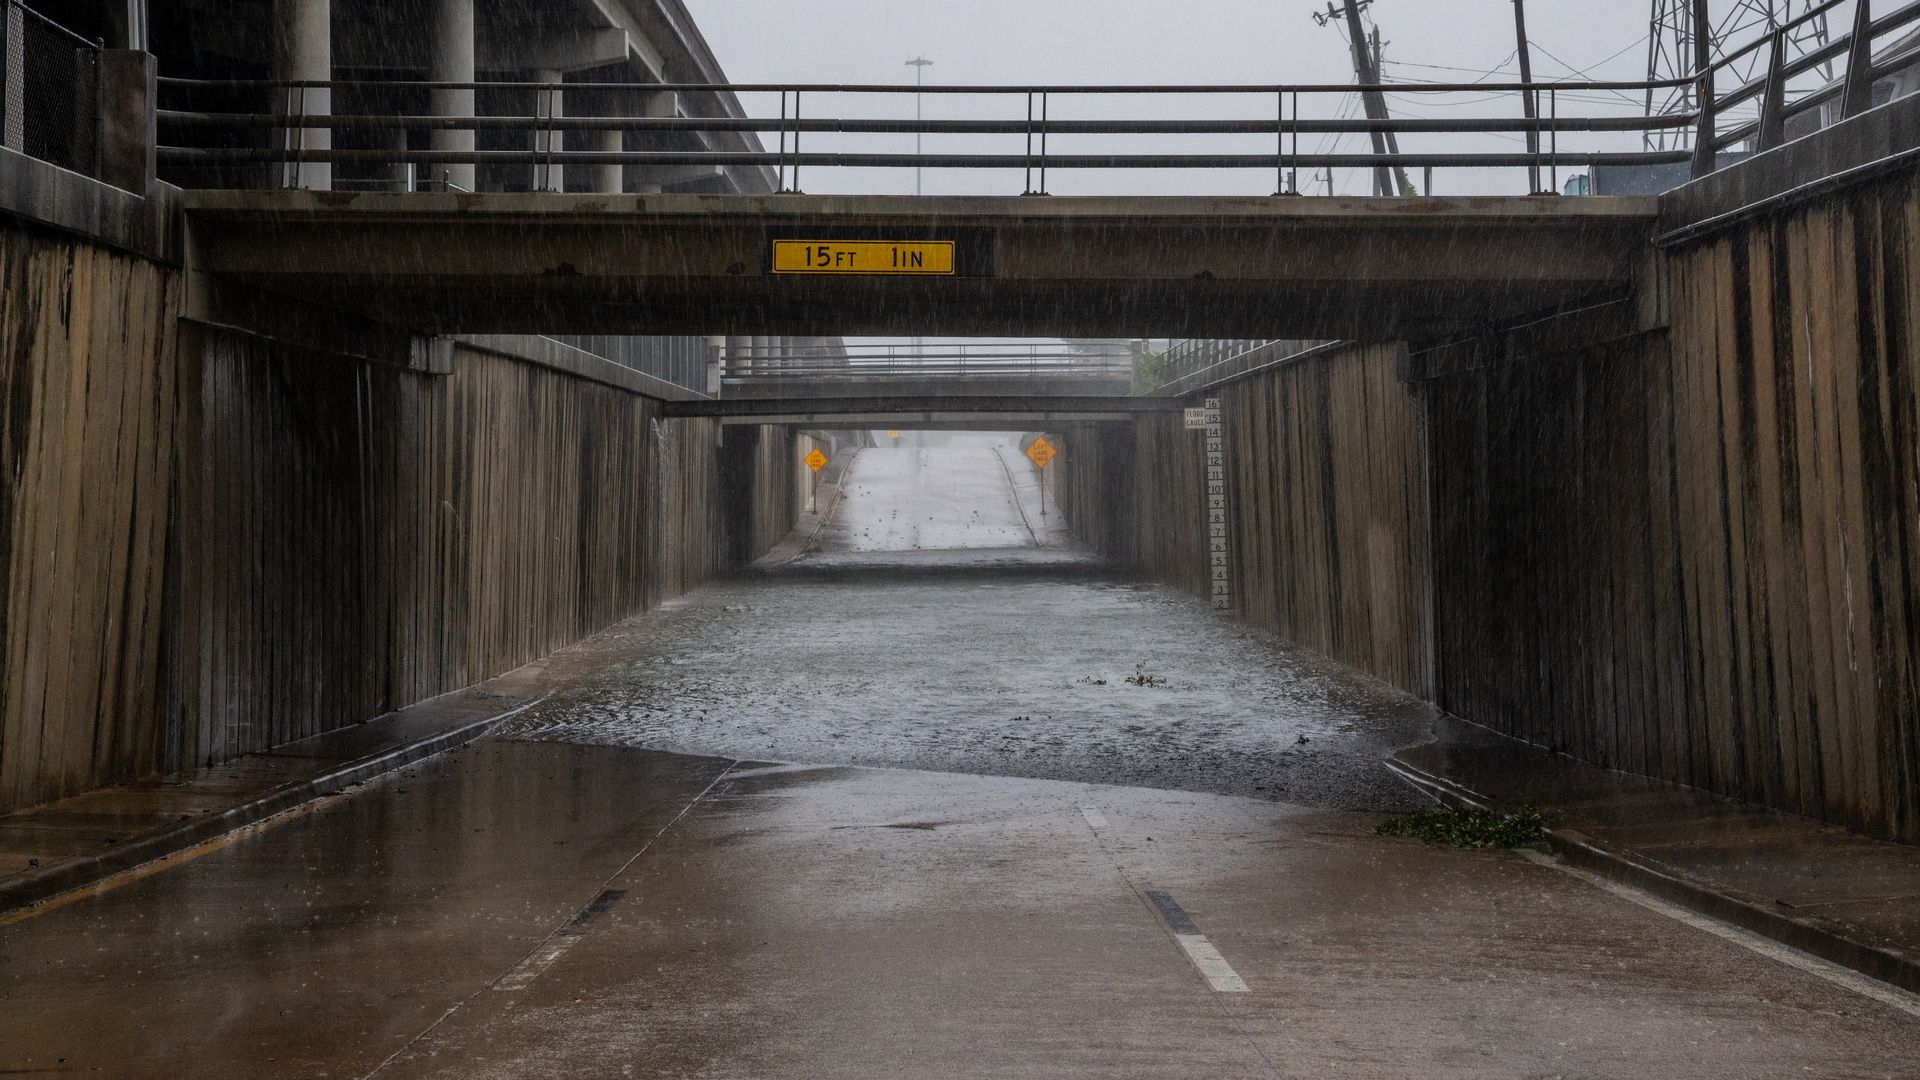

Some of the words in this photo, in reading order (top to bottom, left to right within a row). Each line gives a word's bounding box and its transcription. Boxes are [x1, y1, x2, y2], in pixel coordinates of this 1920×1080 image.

[805, 246, 856, 267] 15FT
[892, 247, 922, 267] 1IN
[1208, 400, 1217, 408] 16
[1209, 414, 1218, 422] 15
[1210, 442, 1218, 451] 13
[1210, 456, 1220, 465] 12
[1212, 485, 1220, 493] 10
[1216, 556, 1222, 565] 5
[1218, 586, 1223, 594] 3
